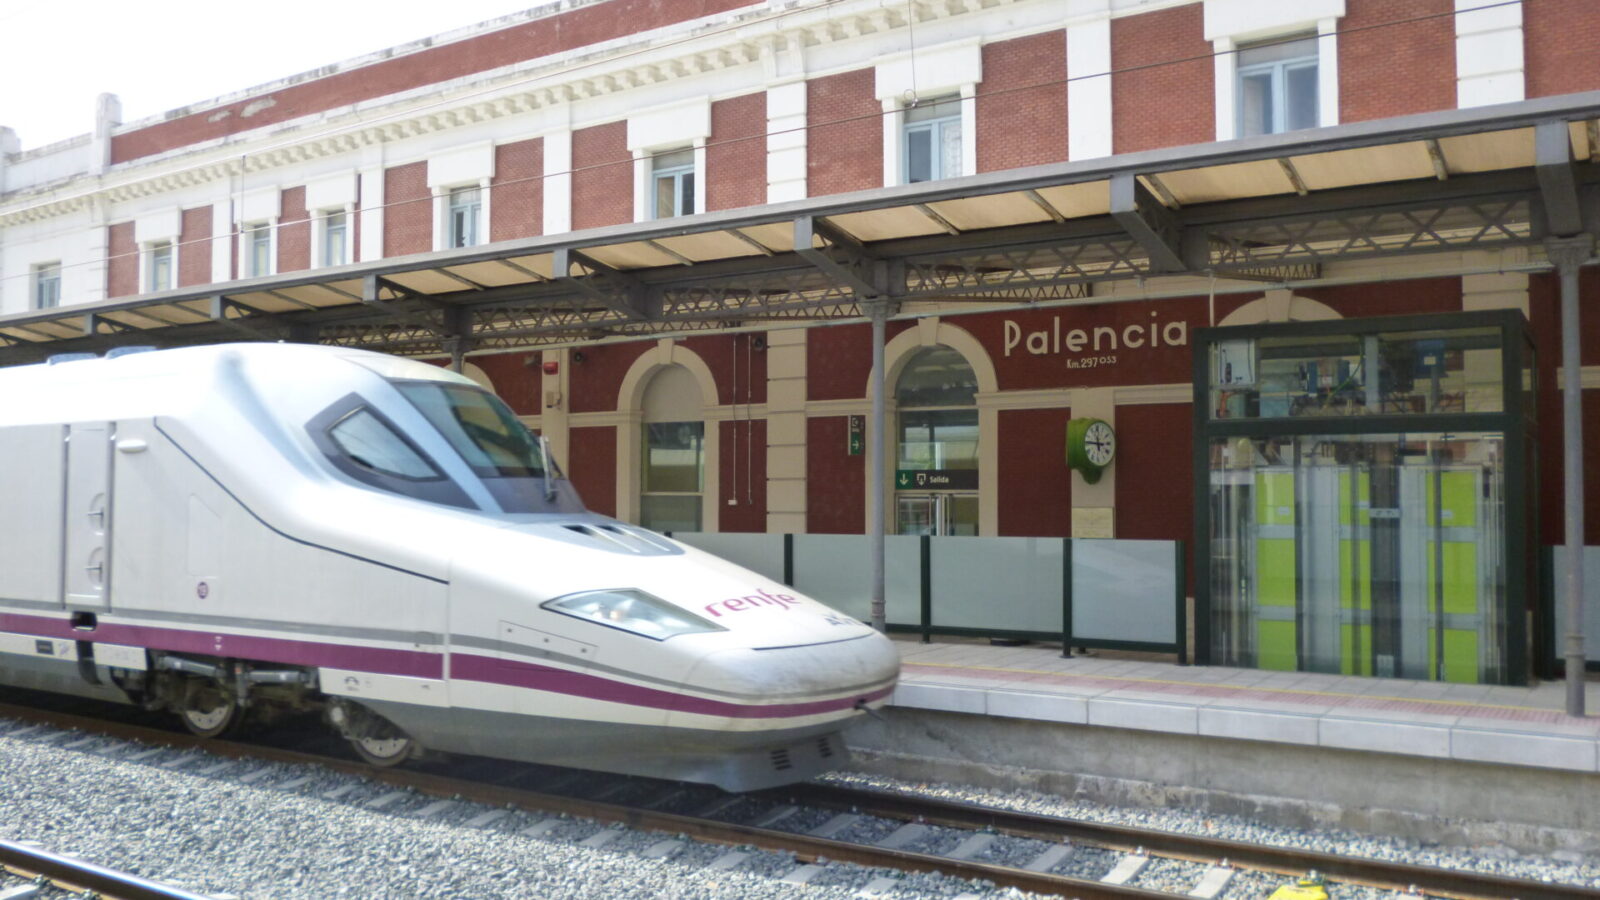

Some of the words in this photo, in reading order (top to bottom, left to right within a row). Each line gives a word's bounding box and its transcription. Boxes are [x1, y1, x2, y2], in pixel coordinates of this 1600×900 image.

[1004, 311, 1187, 357] Palencia
[929, 475, 949, 484] Salida
[704, 588, 801, 617] renfe
